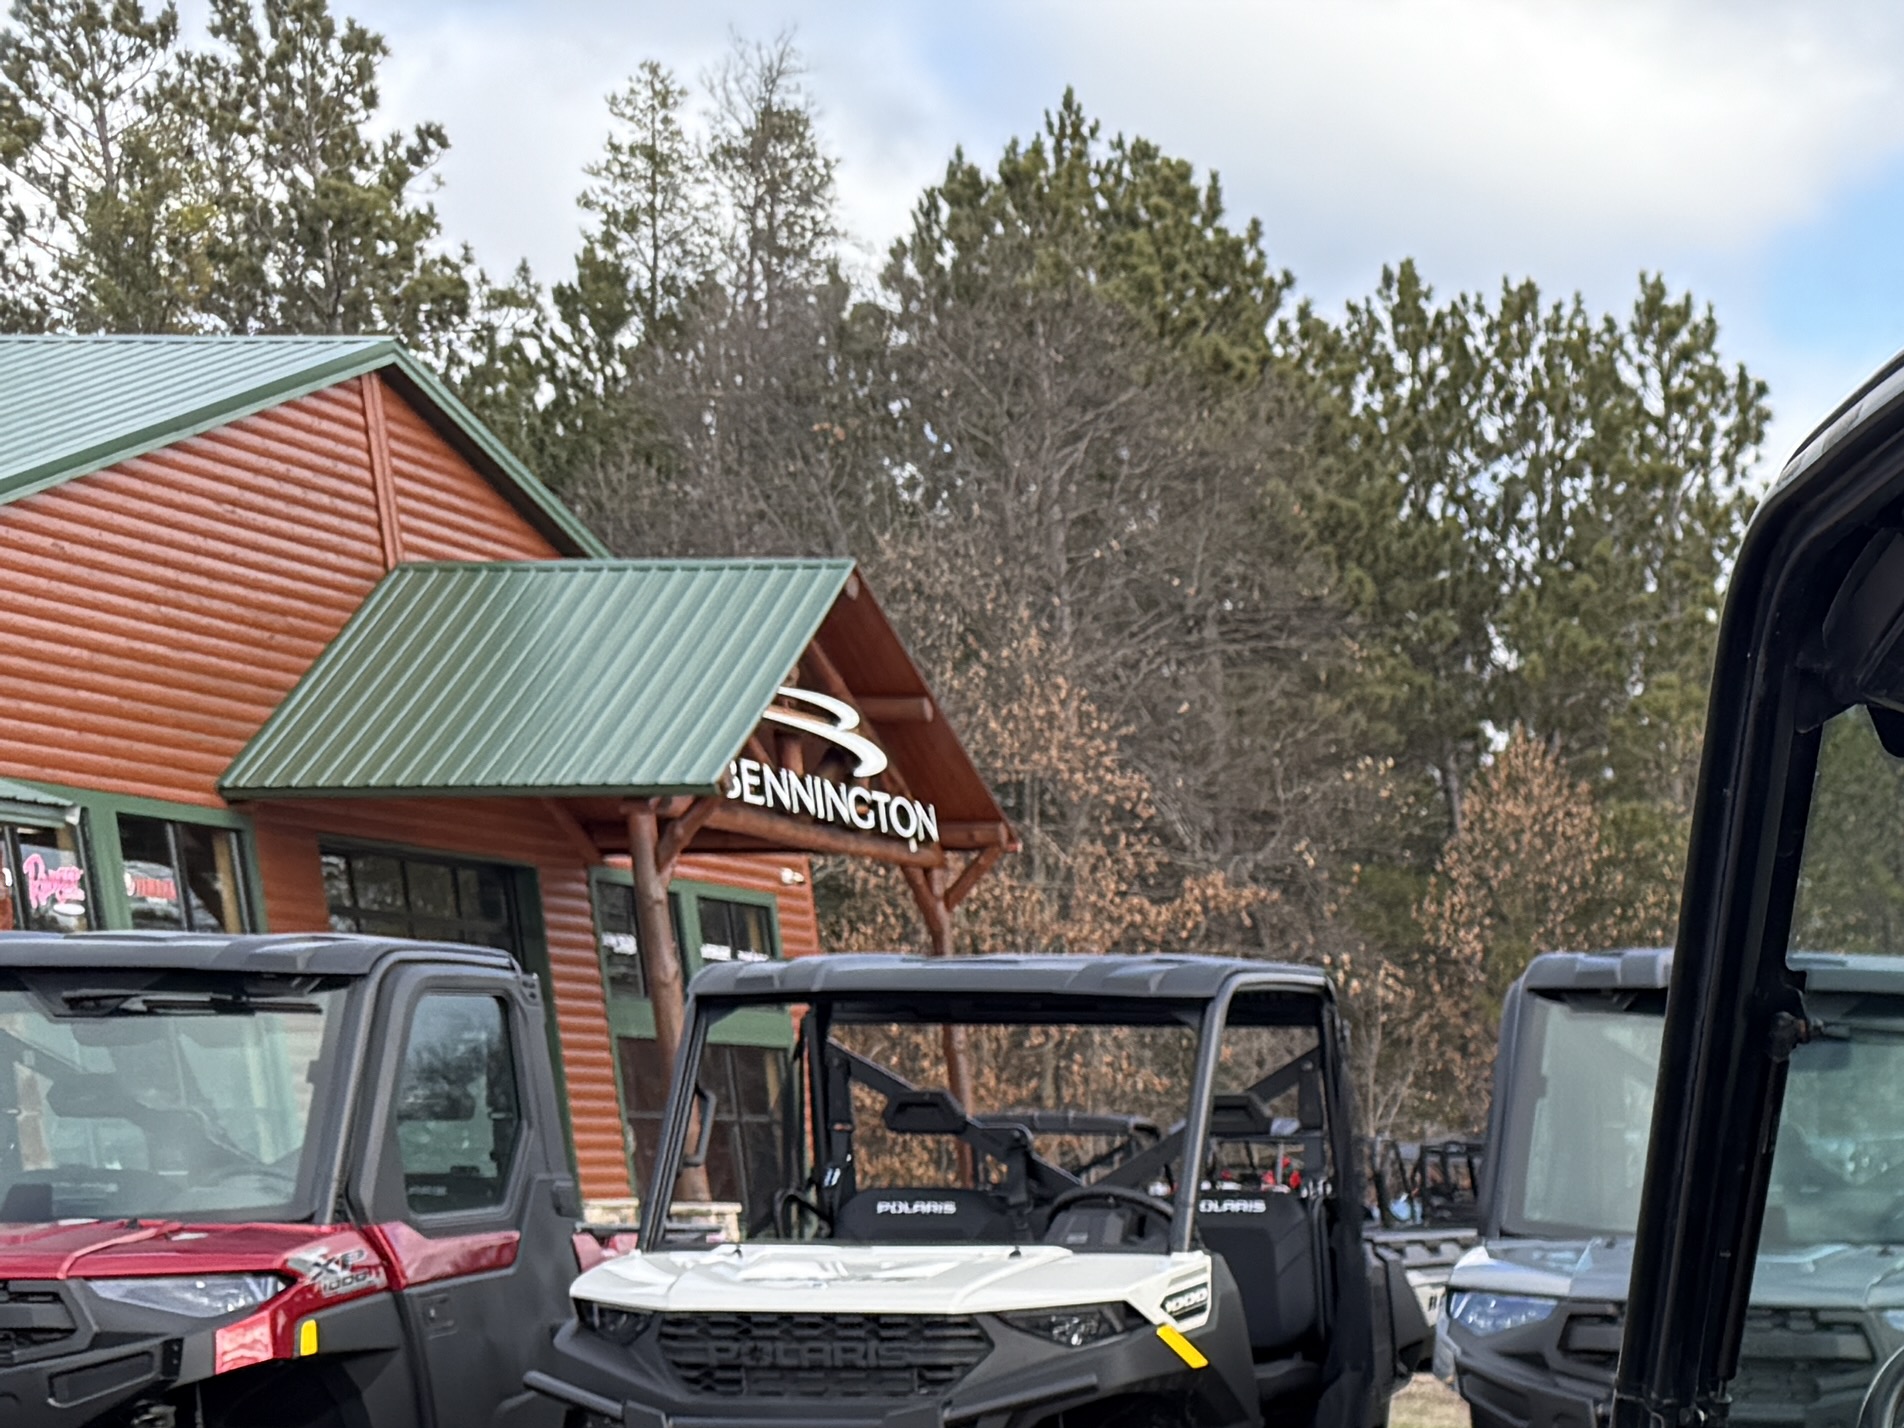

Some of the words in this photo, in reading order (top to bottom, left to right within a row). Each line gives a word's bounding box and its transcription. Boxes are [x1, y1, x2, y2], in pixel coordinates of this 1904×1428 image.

[876, 1200, 957, 1215] POLARIS
[1199, 1199, 1266, 1213] OLARIS
[1164, 1287, 1208, 1313] 1000
[707, 1340, 909, 1368] POLARIS
